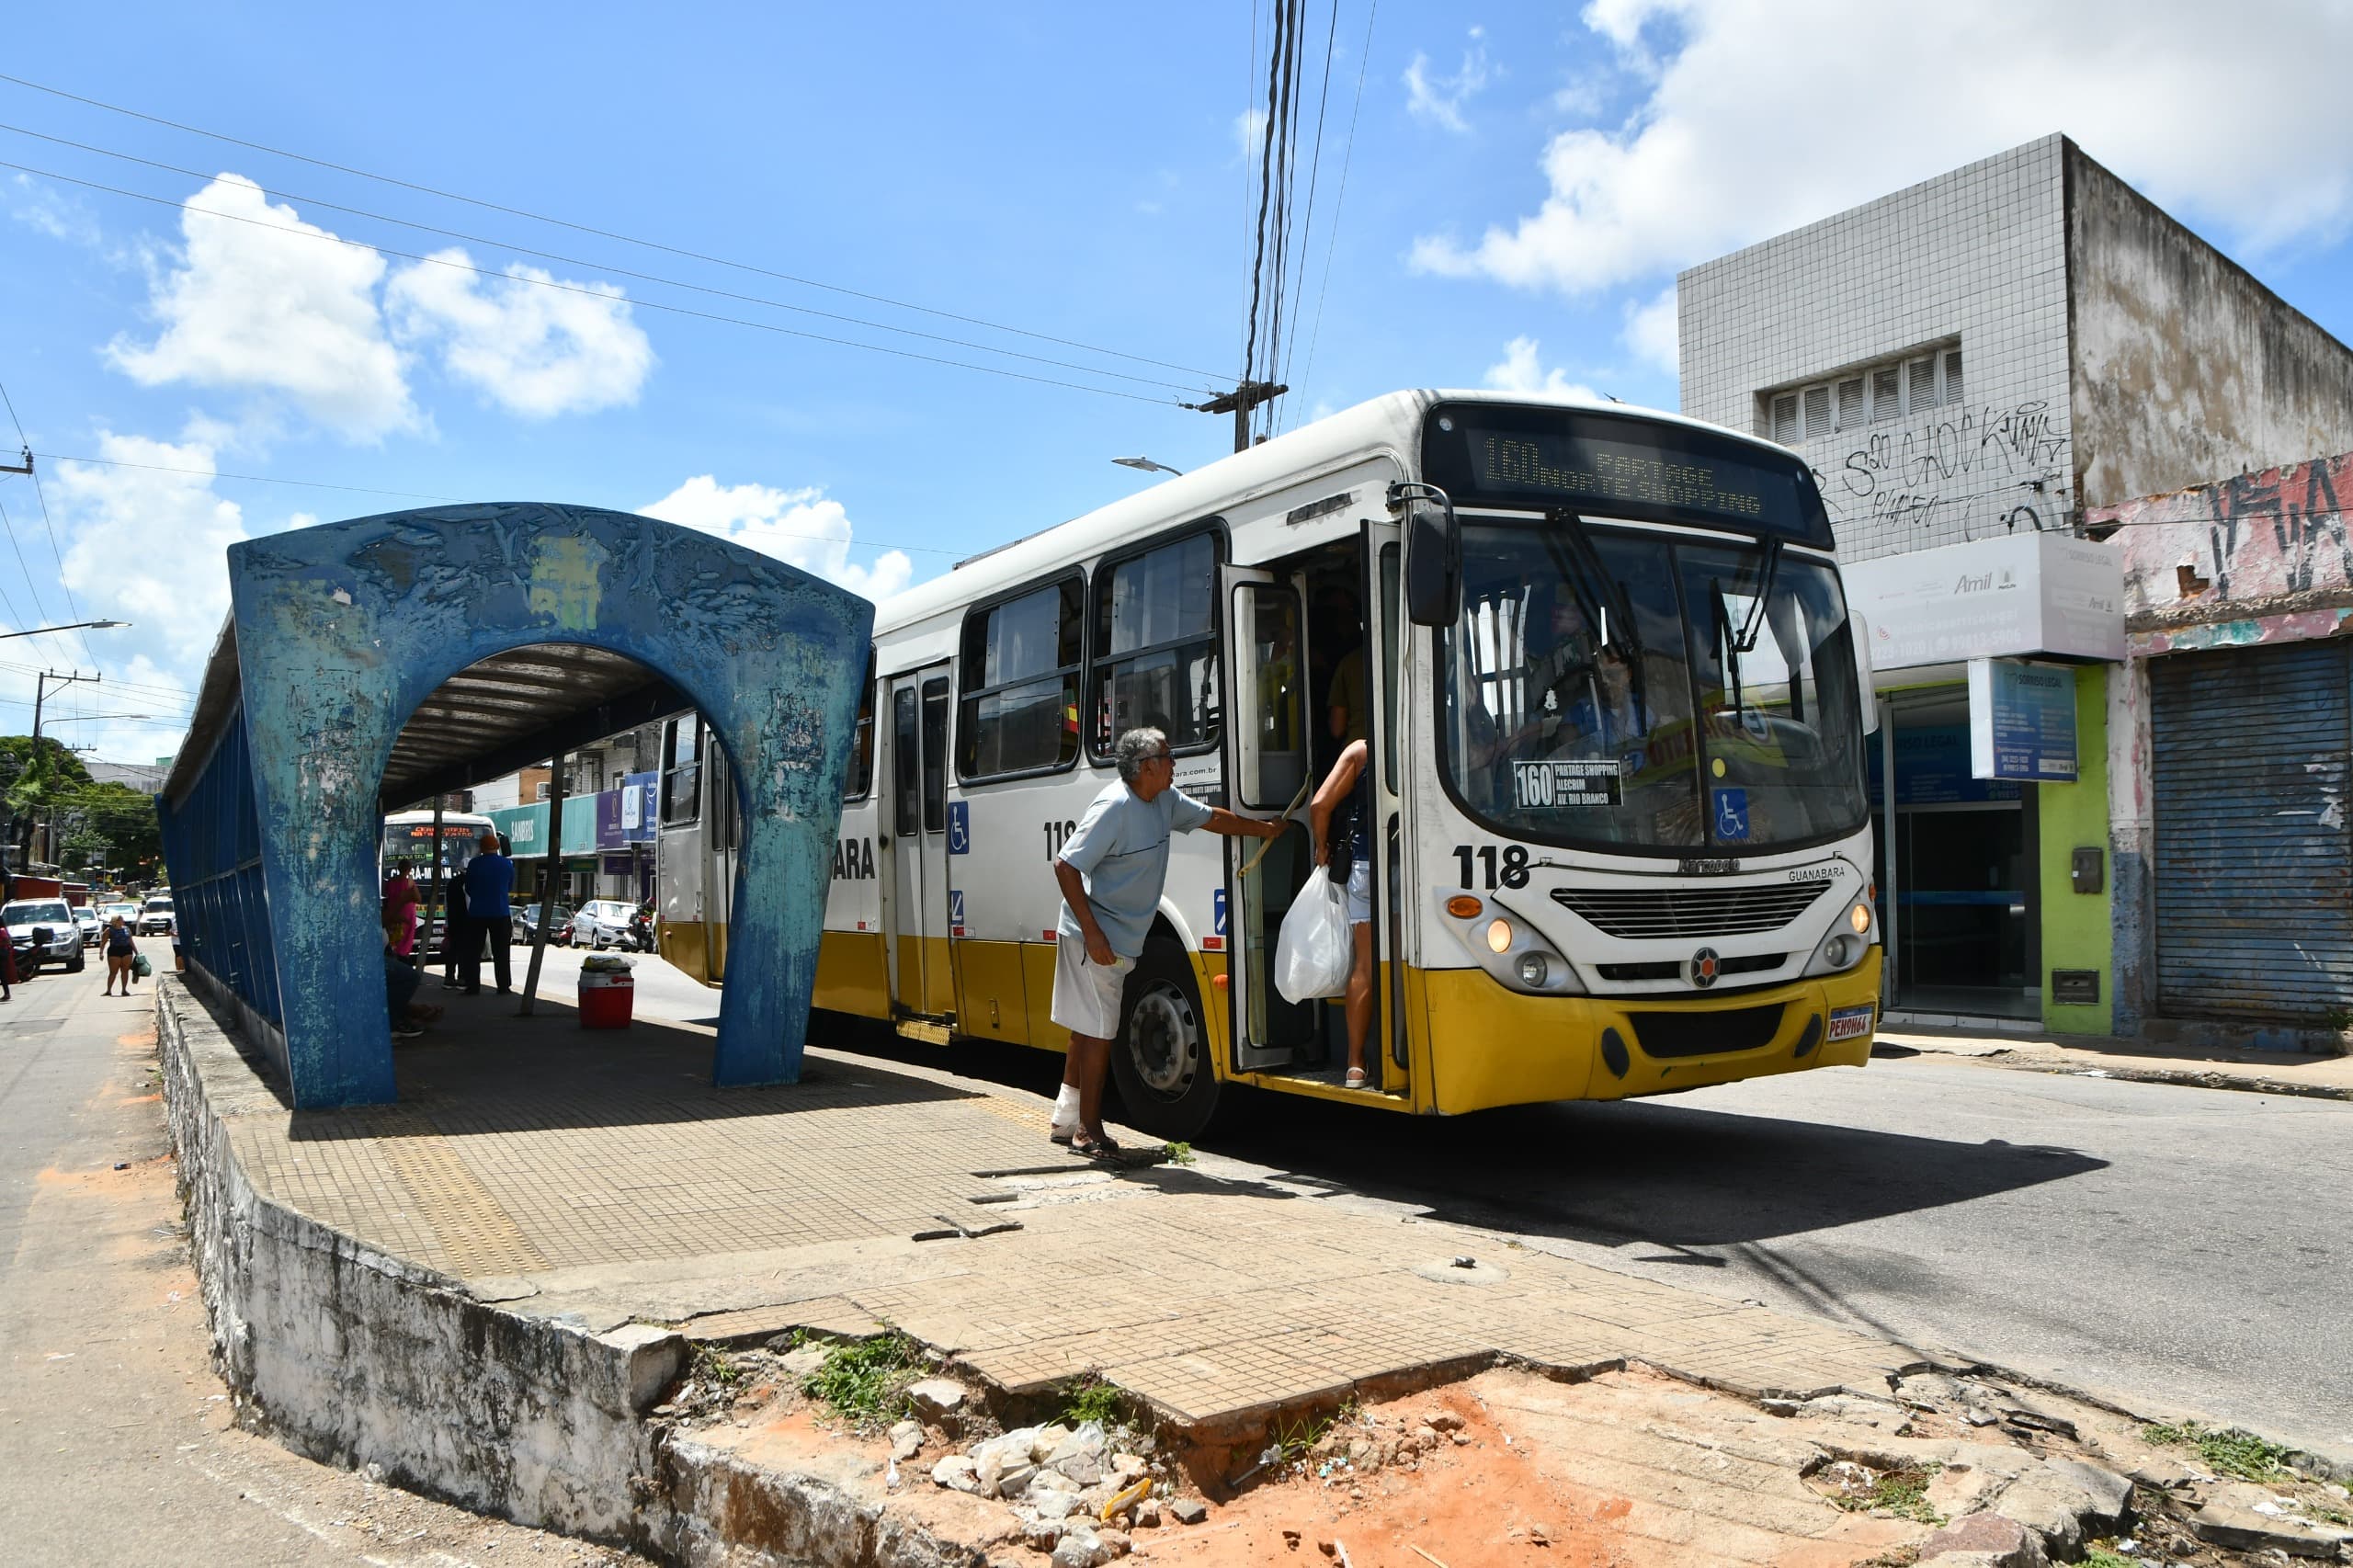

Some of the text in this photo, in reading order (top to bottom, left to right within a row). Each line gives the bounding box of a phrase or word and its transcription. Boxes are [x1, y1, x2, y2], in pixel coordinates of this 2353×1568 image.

[1484, 437, 1538, 484] 160
[1597, 453, 1713, 488] PARTAGE
[1540, 467, 1761, 514] NORTE SHOPPING
[1954, 571, 1993, 596] Amil
[1517, 764, 1553, 807] 160
[1554, 764, 1618, 777] PARTAGE SHOPPING
[1556, 778, 1586, 790] ALECRIM
[1557, 792, 1608, 806] AV. RIO BRANCO
[833, 836, 875, 880] ARA
[1452, 845, 1531, 891] 118
[1678, 858, 1740, 873] Marcopolo
[1789, 867, 1845, 882] GUANABARA
